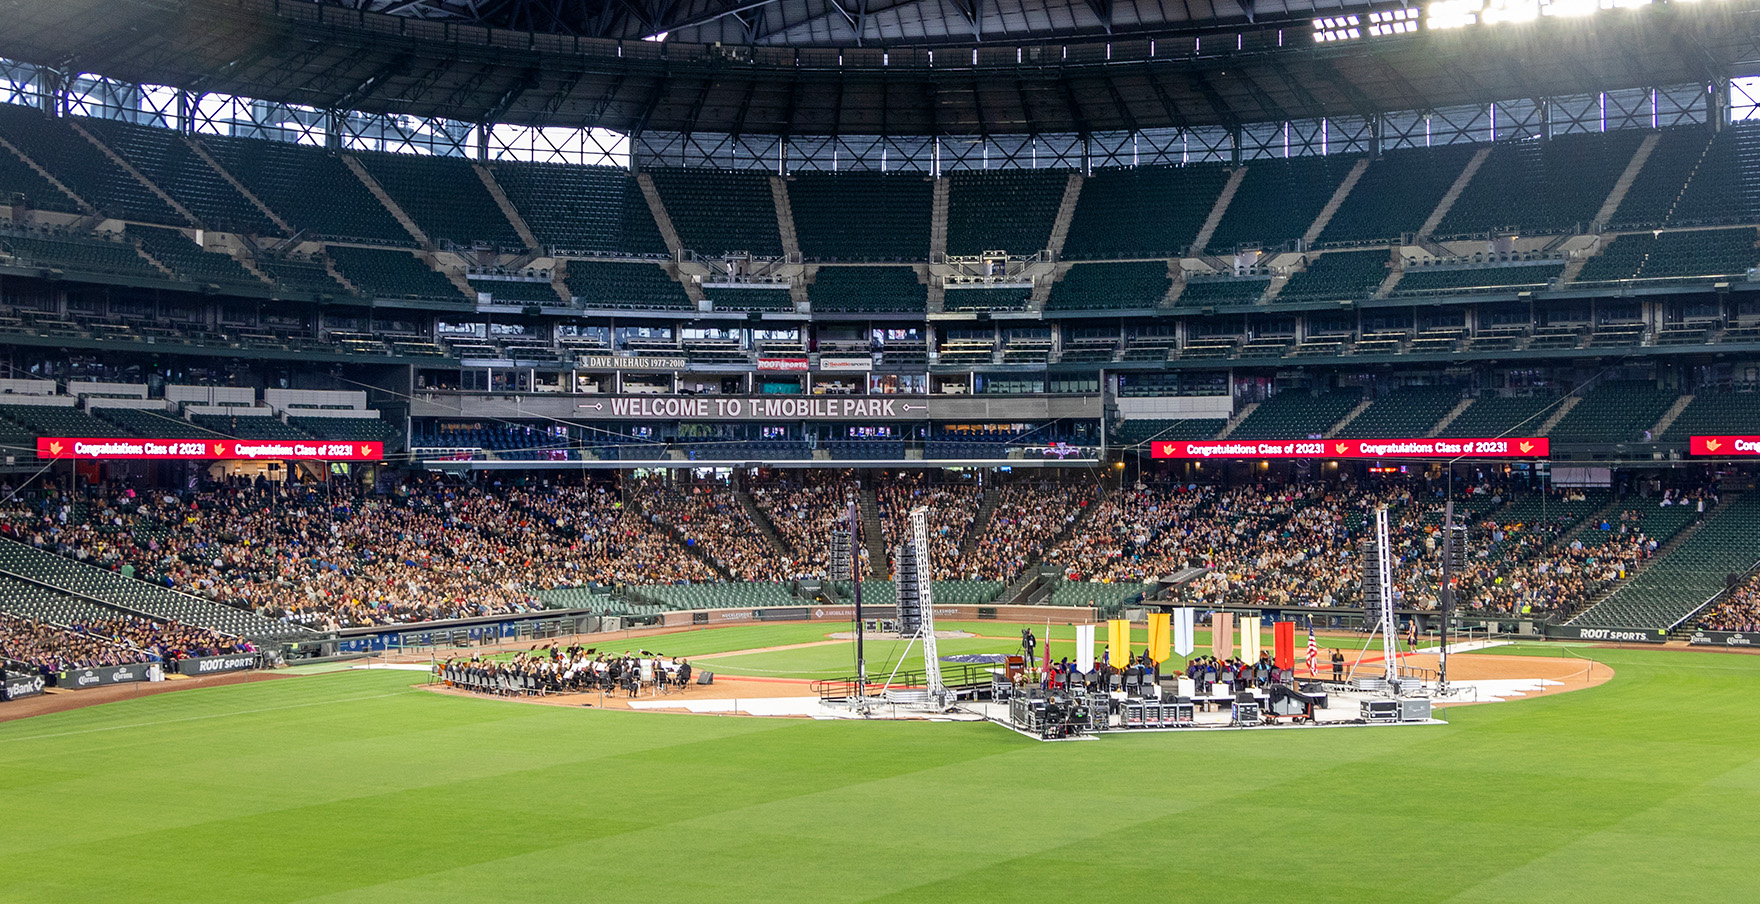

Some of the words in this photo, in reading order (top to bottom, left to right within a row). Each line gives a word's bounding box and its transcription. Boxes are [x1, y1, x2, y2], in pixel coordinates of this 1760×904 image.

[590, 357, 612, 367] DAVE
[613, 357, 649, 368] NIEHAUS
[650, 359, 685, 368] 1977-2010
[611, 398, 708, 416] WELCOME
[716, 398, 742, 416] TO
[749, 398, 838, 416] T-MOBILE
[843, 398, 896, 416] PARK
[74, 442, 143, 457] Congratulations
[144, 443, 168, 455] Class
[168, 443, 178, 455] of
[179, 443, 206, 455] 2023!
[235, 444, 293, 458] Congratulations
[294, 444, 317, 456] Class
[318, 444, 327, 456] of
[328, 445, 353, 456] 2023!
[1186, 444, 1257, 457] Congratulations
[1258, 444, 1283, 455] Class
[1284, 444, 1294, 455] of
[1295, 444, 1325, 455] 2023!
[1359, 443, 1434, 456] Congratulations
[1434, 443, 1461, 453] Class
[1462, 442, 1474, 453] of
[1475, 442, 1508, 453] 2023!
[1580, 628, 1610, 639] ROOT
[1610, 631, 1647, 640] SPORTS
[1726, 636, 1750, 646] Corona
[200, 658, 225, 671] ROOT
[225, 657, 254, 669] SPORTS
[78, 675, 100, 686] Corona
[112, 671, 133, 682] Corona
